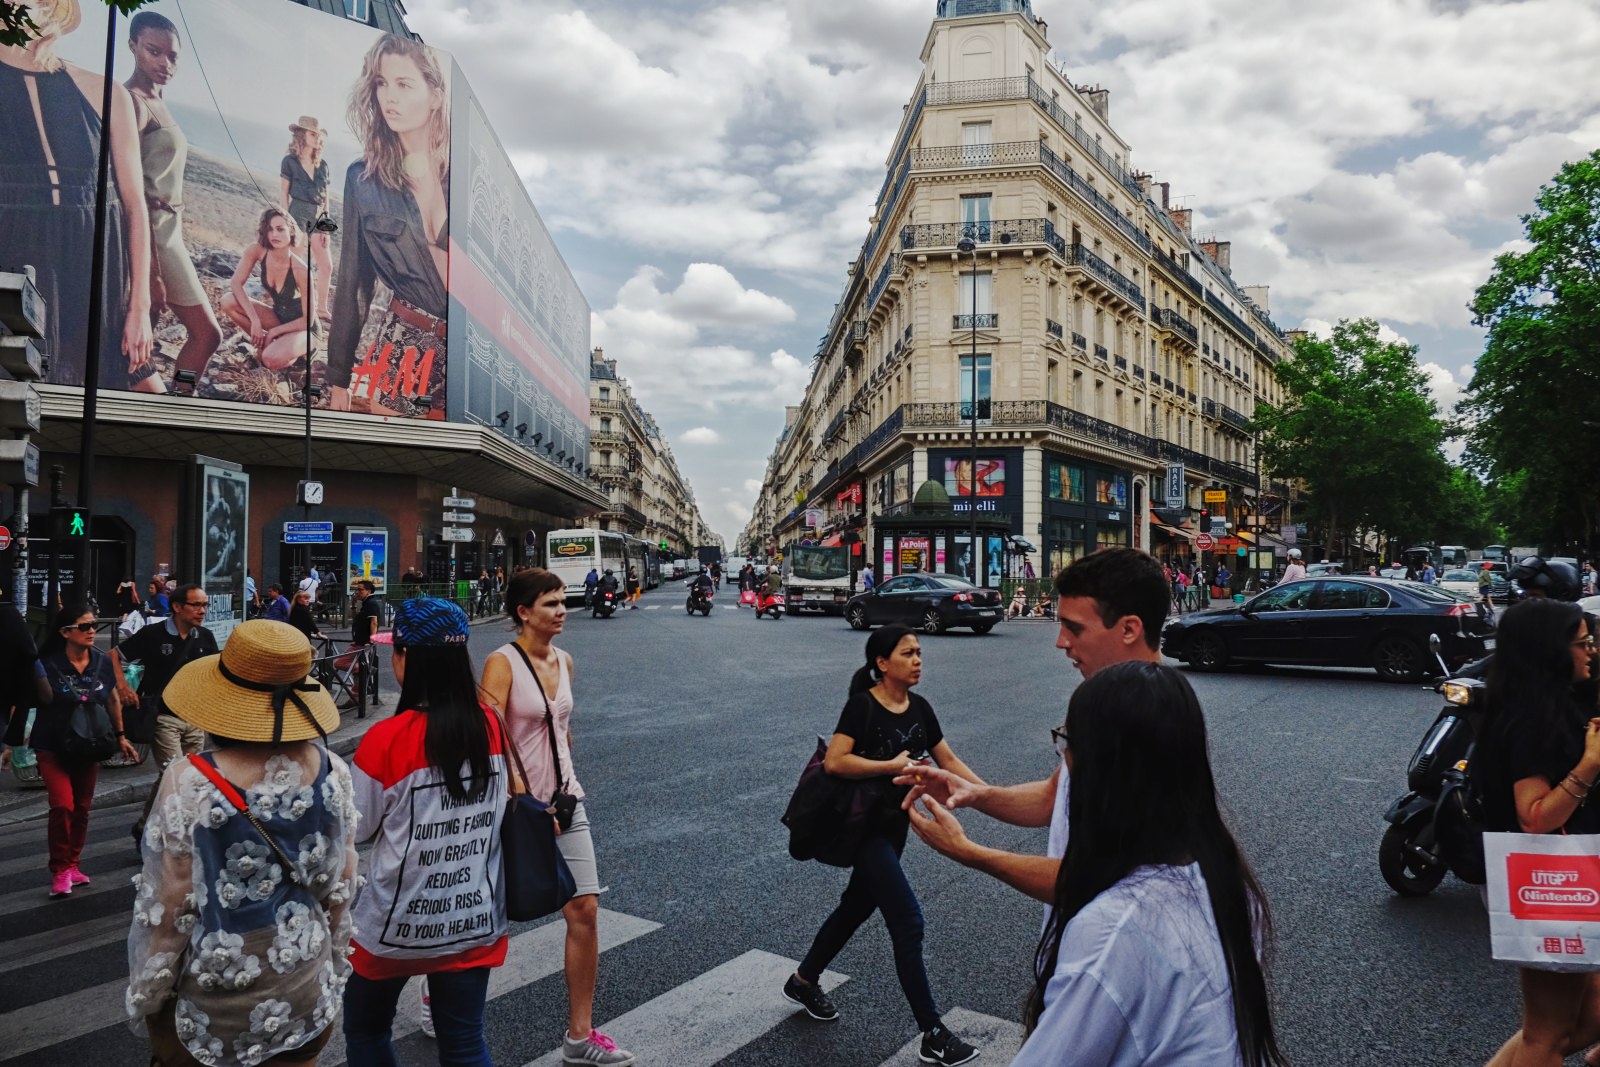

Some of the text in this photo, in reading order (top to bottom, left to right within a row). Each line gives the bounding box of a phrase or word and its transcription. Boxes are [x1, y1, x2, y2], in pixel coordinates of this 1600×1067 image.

[900, 541, 909, 549] Le
[444, 634, 466, 643] PARIS
[414, 818, 460, 841] QUITTING
[418, 838, 488, 866] NOW GREATLY
[425, 866, 471, 890] REDUCES
[406, 889, 483, 915] SERIOUS RISKS
[1524, 891, 1592, 902] Nintendo
[395, 912, 488, 939] TO YOUR HEALTH
